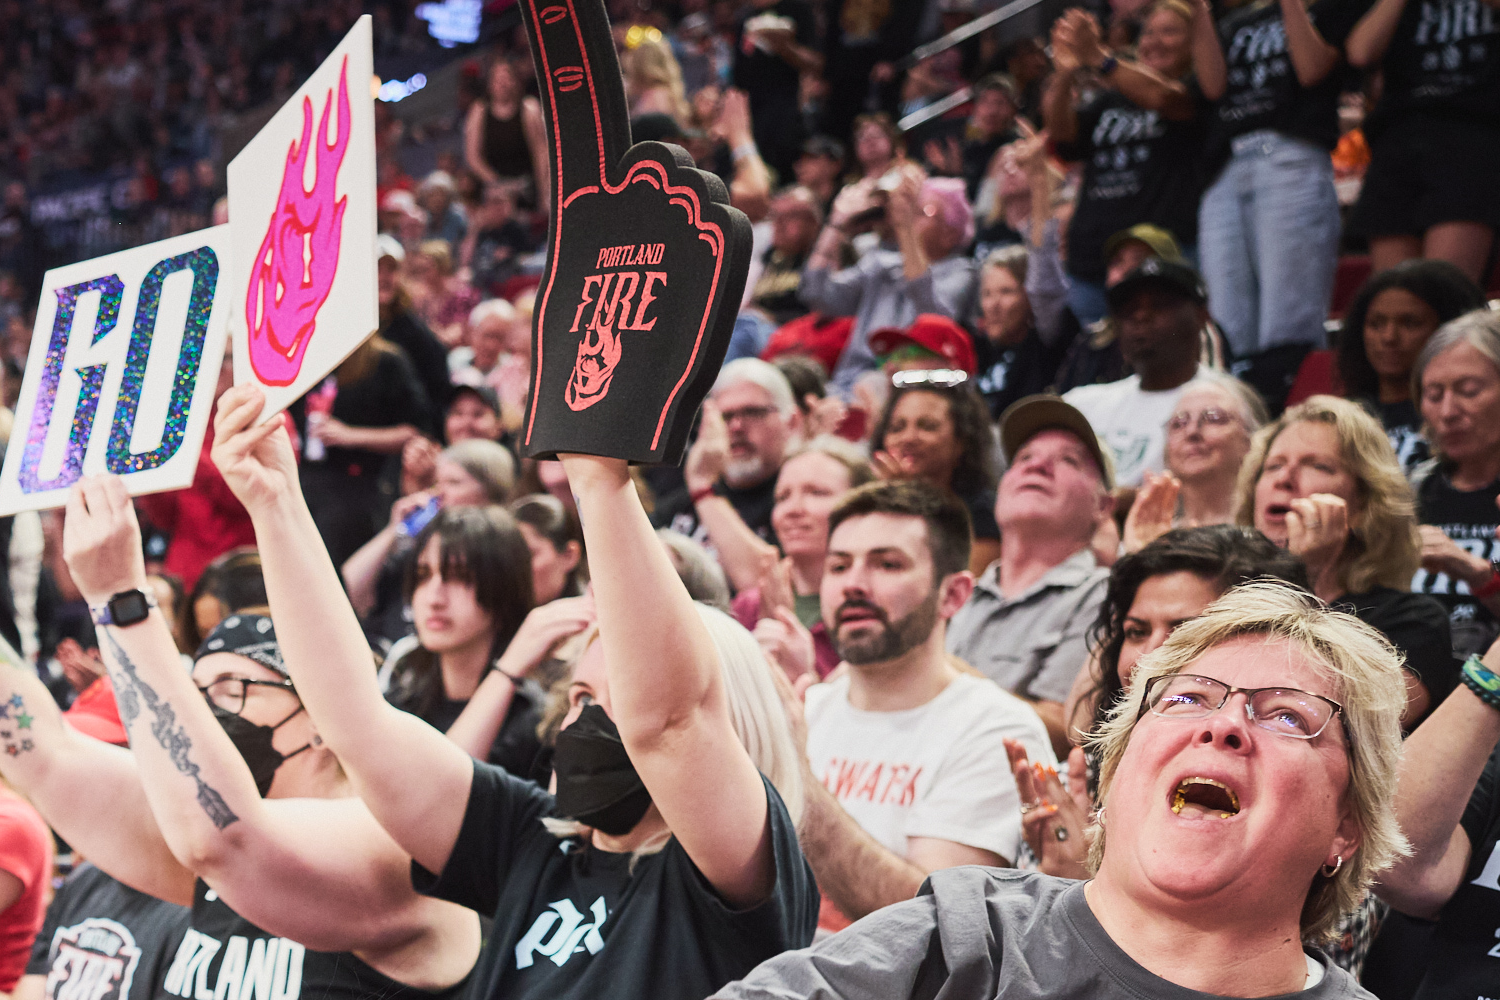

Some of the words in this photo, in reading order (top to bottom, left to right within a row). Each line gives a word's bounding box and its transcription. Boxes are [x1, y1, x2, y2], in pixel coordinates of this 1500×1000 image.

[595, 243, 666, 269] PORTLAND
[568, 271, 668, 332] FIRE
[17, 245, 220, 494] GO
